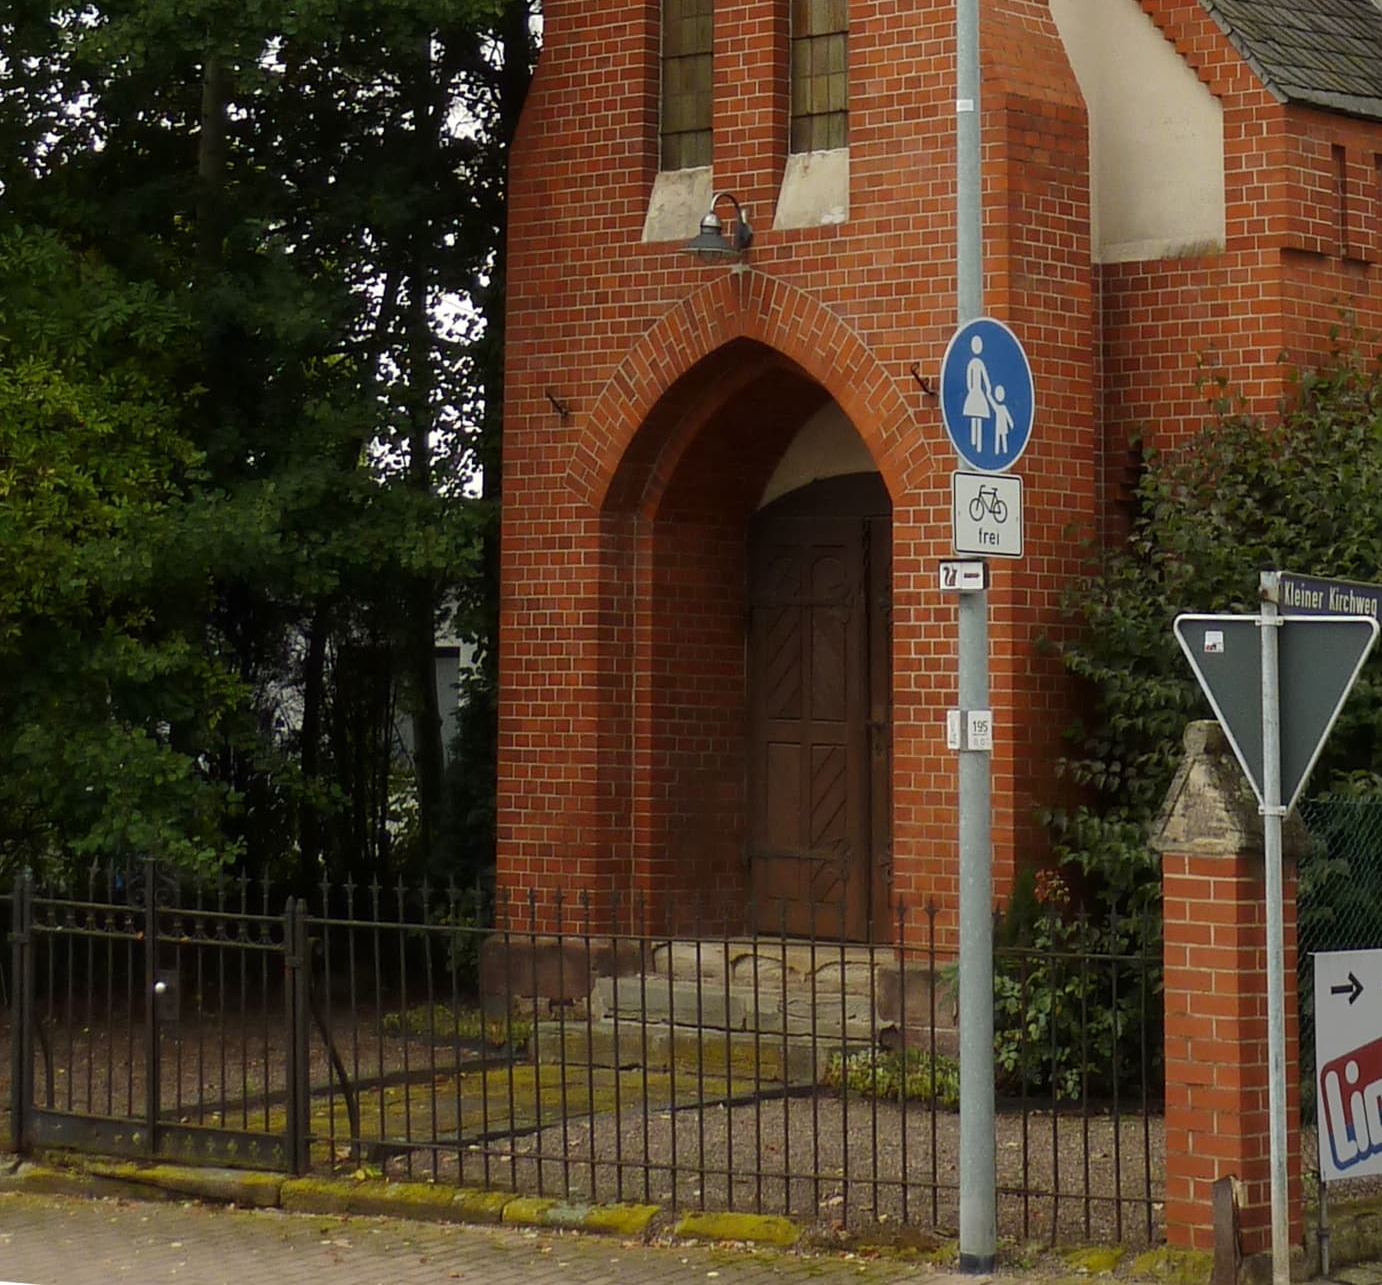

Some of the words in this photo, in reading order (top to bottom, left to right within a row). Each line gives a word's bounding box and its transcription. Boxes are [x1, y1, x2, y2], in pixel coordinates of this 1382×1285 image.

[979, 527, 1000, 546] frei
[1284, 580, 1324, 609] Kleiner
[1329, 586, 1378, 617] Kirchweg
